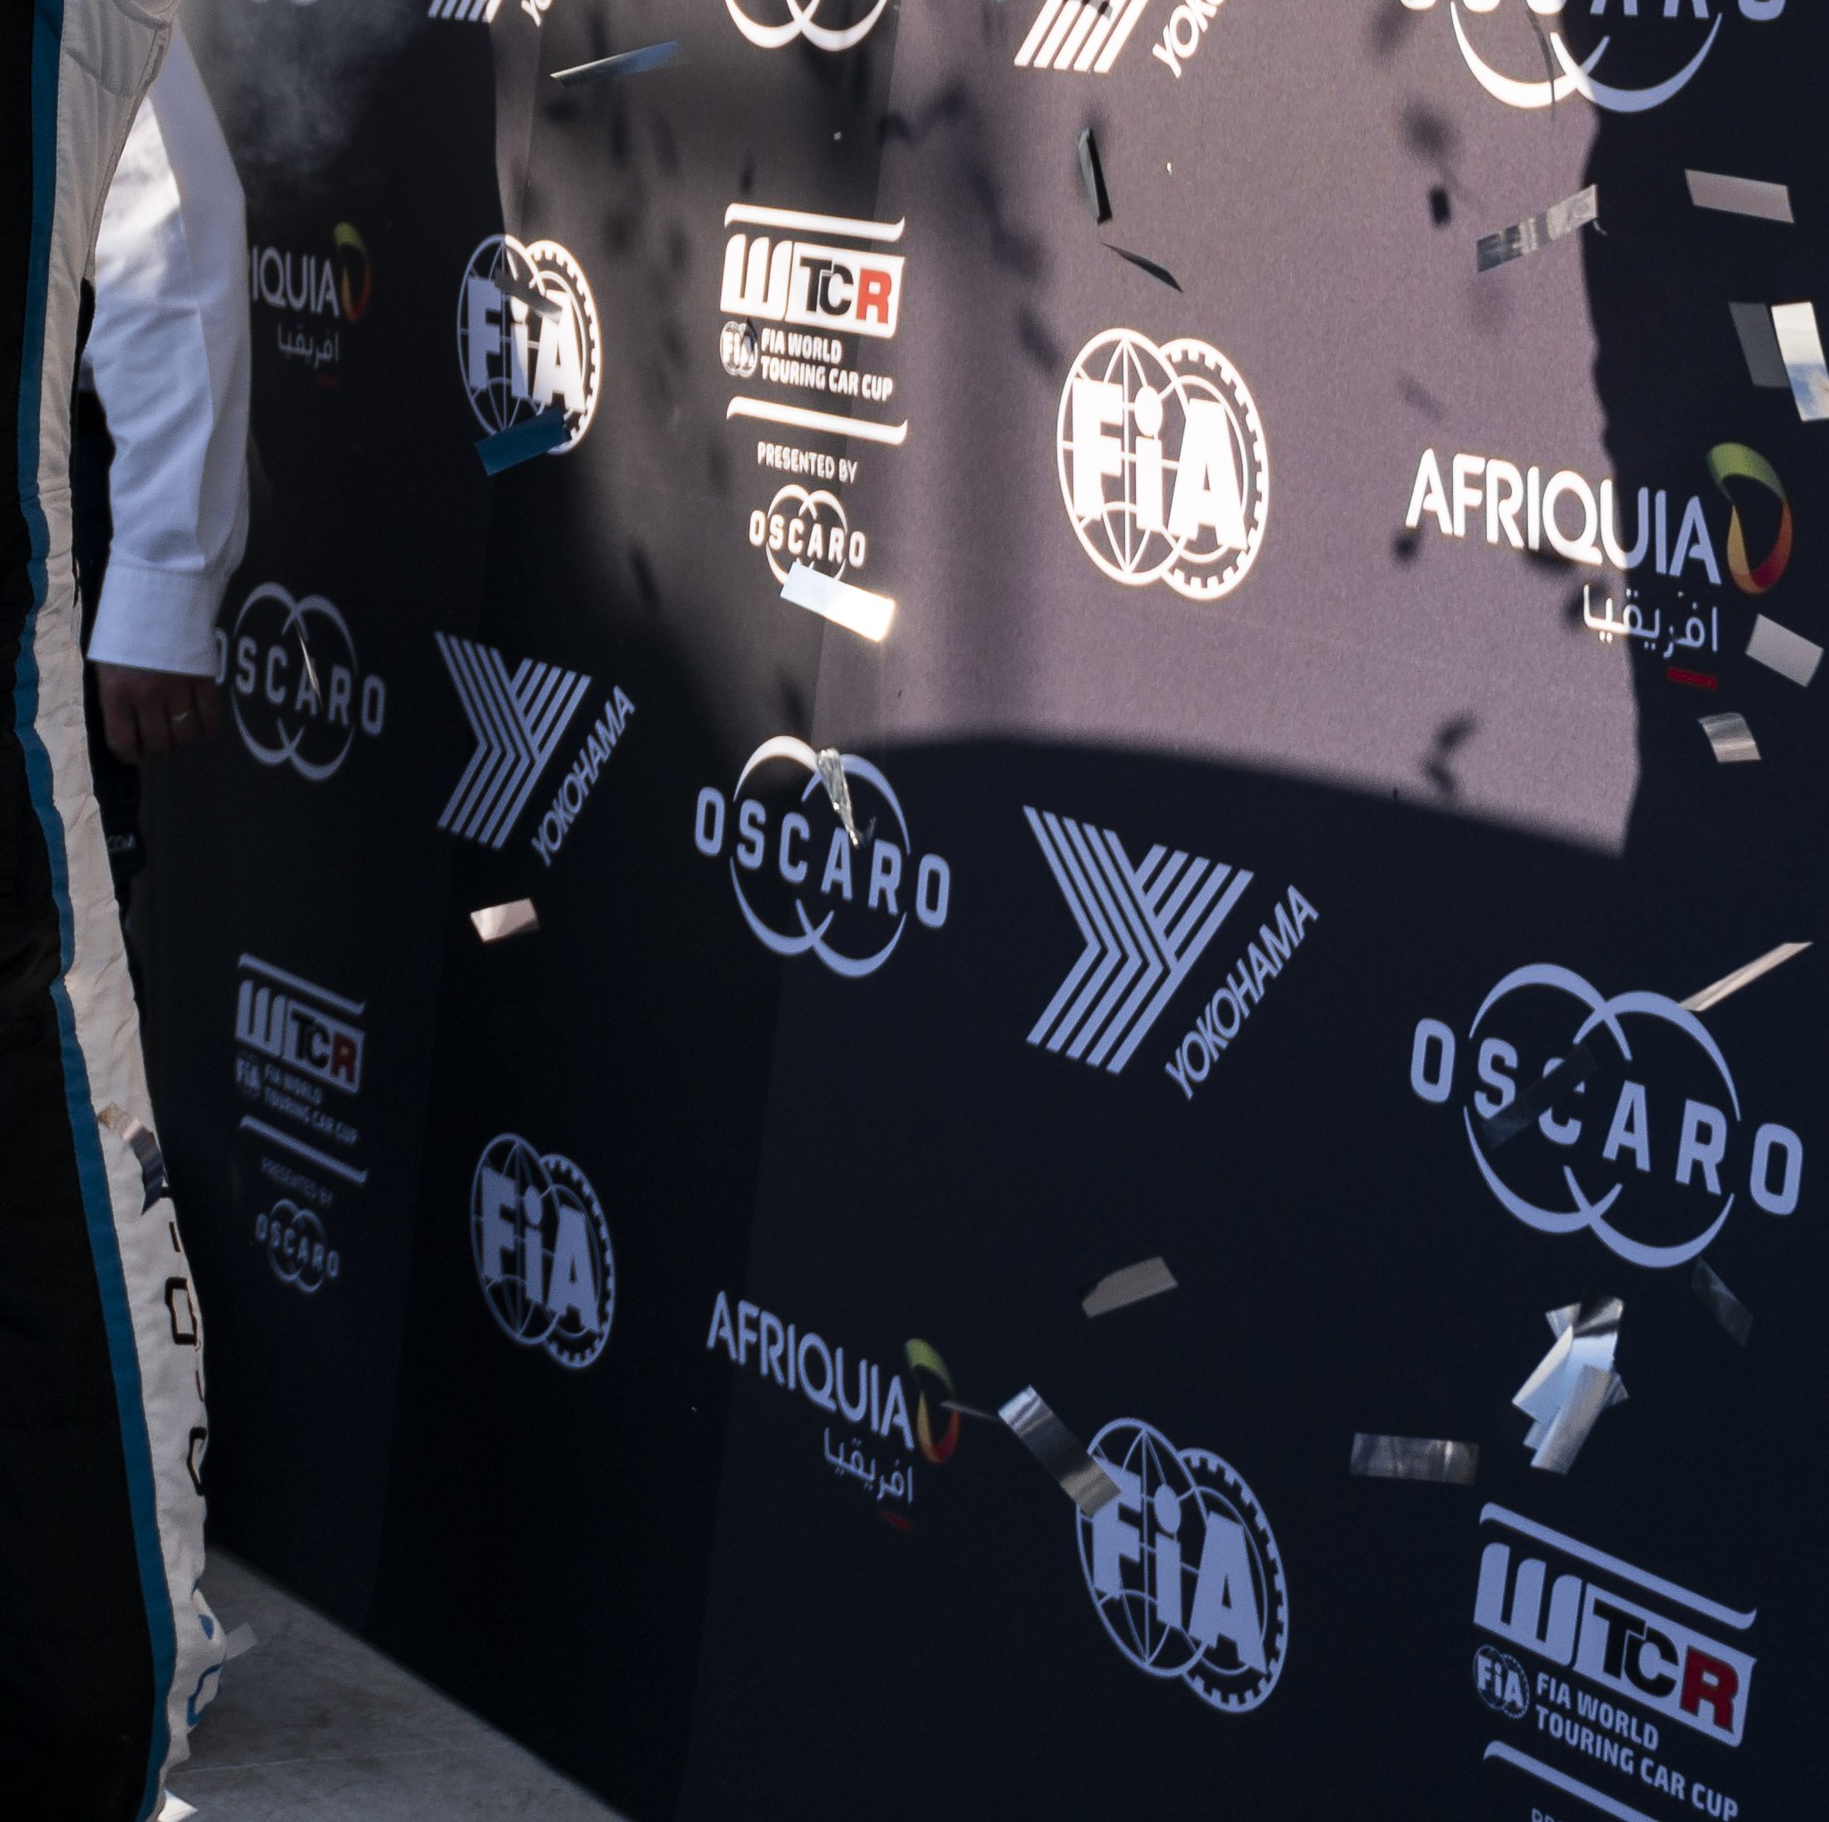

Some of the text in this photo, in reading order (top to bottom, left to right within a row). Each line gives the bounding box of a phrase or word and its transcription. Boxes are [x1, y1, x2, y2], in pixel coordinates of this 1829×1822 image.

[251, 244, 341, 319] IQUIA
[760, 327, 843, 364] FIA WORLD
[760, 354, 894, 403] TOURING CAR CUP
[757, 441, 858, 484] PRESENTED BY
[749, 509, 867, 569] OSCARO
[1404, 448, 1723, 586] AFRIQUIA
[530, 685, 636, 868] YOKOHAMA
[694, 785, 951, 928] OSCARO
[1164, 883, 1320, 1101] YOKOHAMA
[1410, 1018, 1804, 1216] OSCARO
[254, 1212, 341, 1279] OSCARO
[706, 1289, 915, 1451] AFRIQUIA
[1536, 1701, 1740, 1822] TOURING CAR CUP
[1537, 1670, 1660, 1752] FIA WORLD
